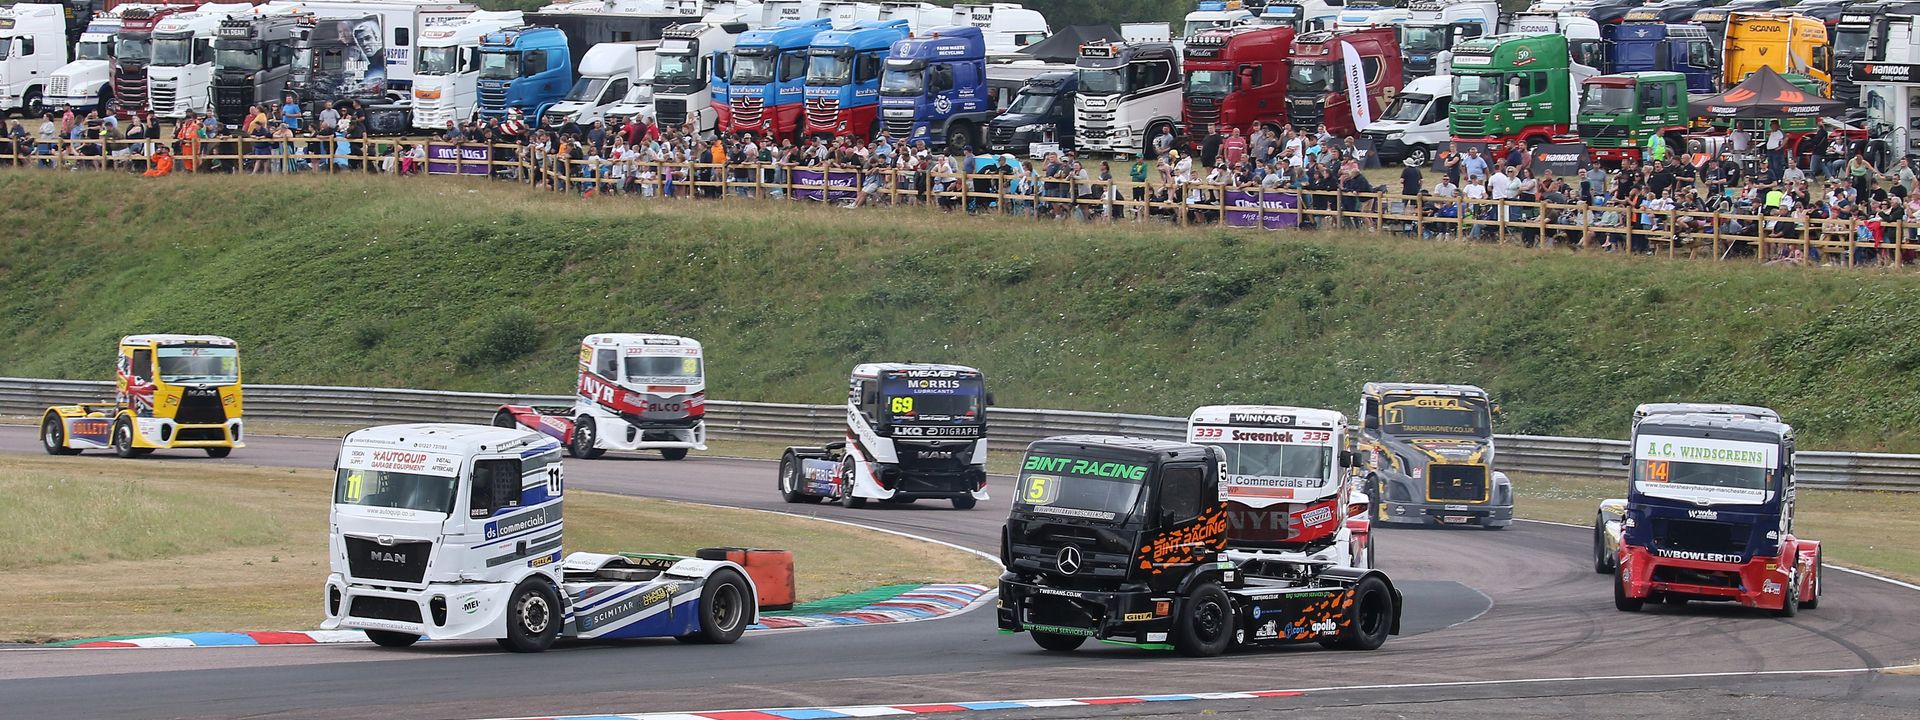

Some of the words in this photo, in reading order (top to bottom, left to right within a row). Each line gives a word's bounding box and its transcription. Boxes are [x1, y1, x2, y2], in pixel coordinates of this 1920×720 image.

[971, 13, 992, 21] PARHAM
[1520, 25, 1549, 33] SCANIA
[1749, 25, 1782, 33] SCANIA
[907, 369, 957, 378] WEAVER
[583, 376, 615, 404] NYR
[648, 403, 680, 412] ALCO
[891, 396, 914, 414] 69
[1235, 413, 1291, 424] WINNARD
[1390, 411, 1398, 423] 7
[72, 421, 109, 435] COLLETT
[893, 427, 922, 436] LKQ
[939, 427, 979, 436] DIGRAPH
[1194, 428, 1223, 438] 333
[1231, 429, 1294, 443] Screentek
[1302, 431, 1331, 442] 333
[379, 451, 427, 464] AUTOQUIP
[917, 450, 952, 459] MAN
[1647, 441, 1661, 456] A.
[1662, 442, 1676, 456] C.
[1680, 445, 1763, 464] WINDSCREENS
[371, 461, 393, 469] GARAGE
[393, 463, 425, 472] EQUIPMENT
[431, 465, 454, 473] AFTERCARE
[1023, 455, 1071, 472] BINT
[1071, 460, 1148, 481] RACING
[1220, 463, 1227, 480] 5
[1648, 462, 1667, 480] 14
[548, 467, 560, 492] 11
[1235, 475, 1303, 488] Commercials
[348, 474, 361, 499] 11
[1029, 479, 1046, 499] 5
[366, 507, 416, 518] www.autoquip.co.uk
[499, 513, 544, 535] commercials
[1227, 511, 1289, 530] NYR
[486, 527, 497, 539] ds
[1183, 519, 1227, 545] RACING
[370, 550, 406, 564] MAN
[1656, 548, 1742, 563] TWBOWLERLTD
[1038, 588, 1082, 598] TWBTRANS.CO.UK
[463, 599, 479, 612] MEI
[594, 601, 635, 624] SCIMITAR
[1035, 624, 1058, 633] SUPPORT
[1058, 626, 1083, 635] SERVICES
[1083, 629, 1094, 637] LTD
[1311, 618, 1337, 635] apollo
